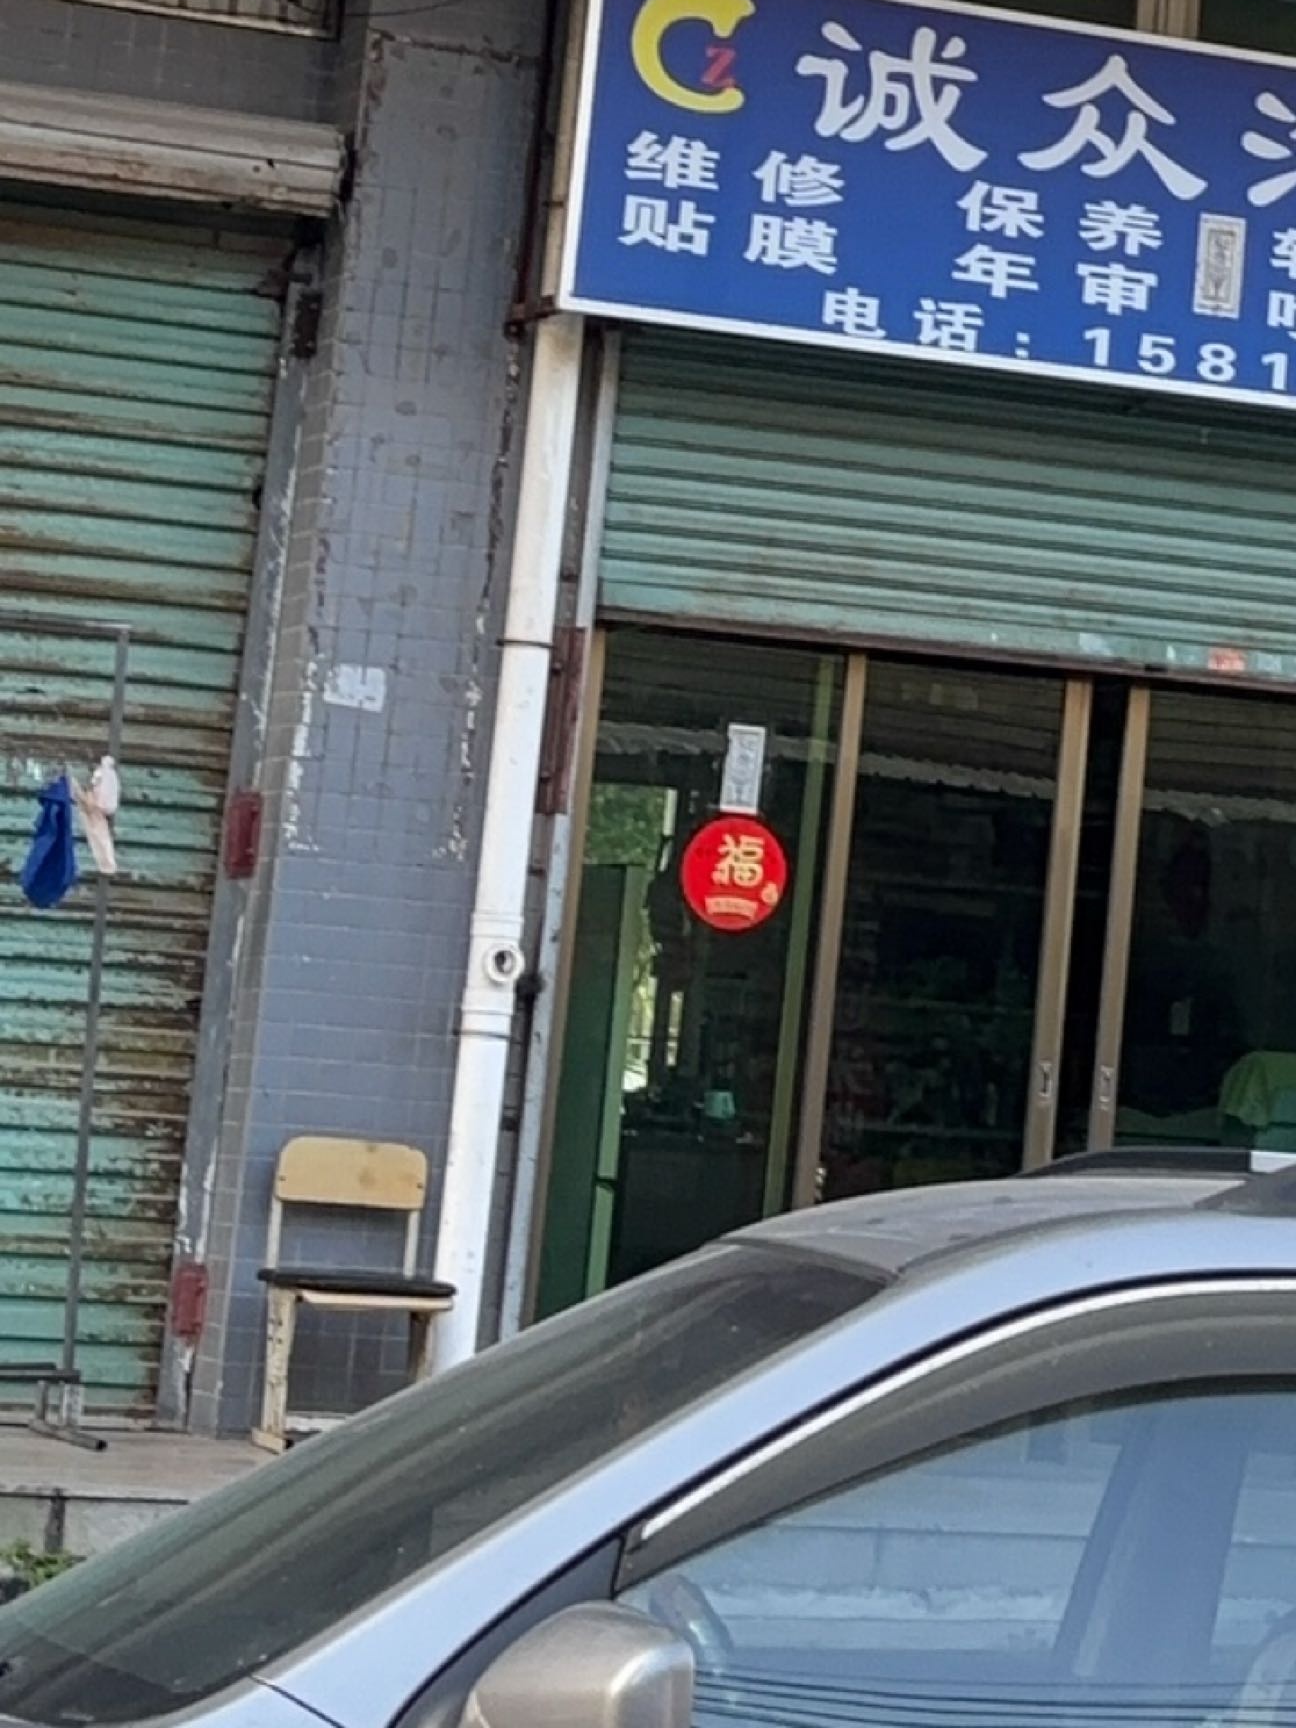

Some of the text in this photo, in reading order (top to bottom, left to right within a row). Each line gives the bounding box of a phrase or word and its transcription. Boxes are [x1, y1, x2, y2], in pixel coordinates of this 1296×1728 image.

[625, 130, 845, 208] 维修
[957, 180, 1163, 256] 保养
[618, 194, 839, 274] 贴膜
[952, 243, 1159, 316] 年审
[711, 833, 765, 888] 福
